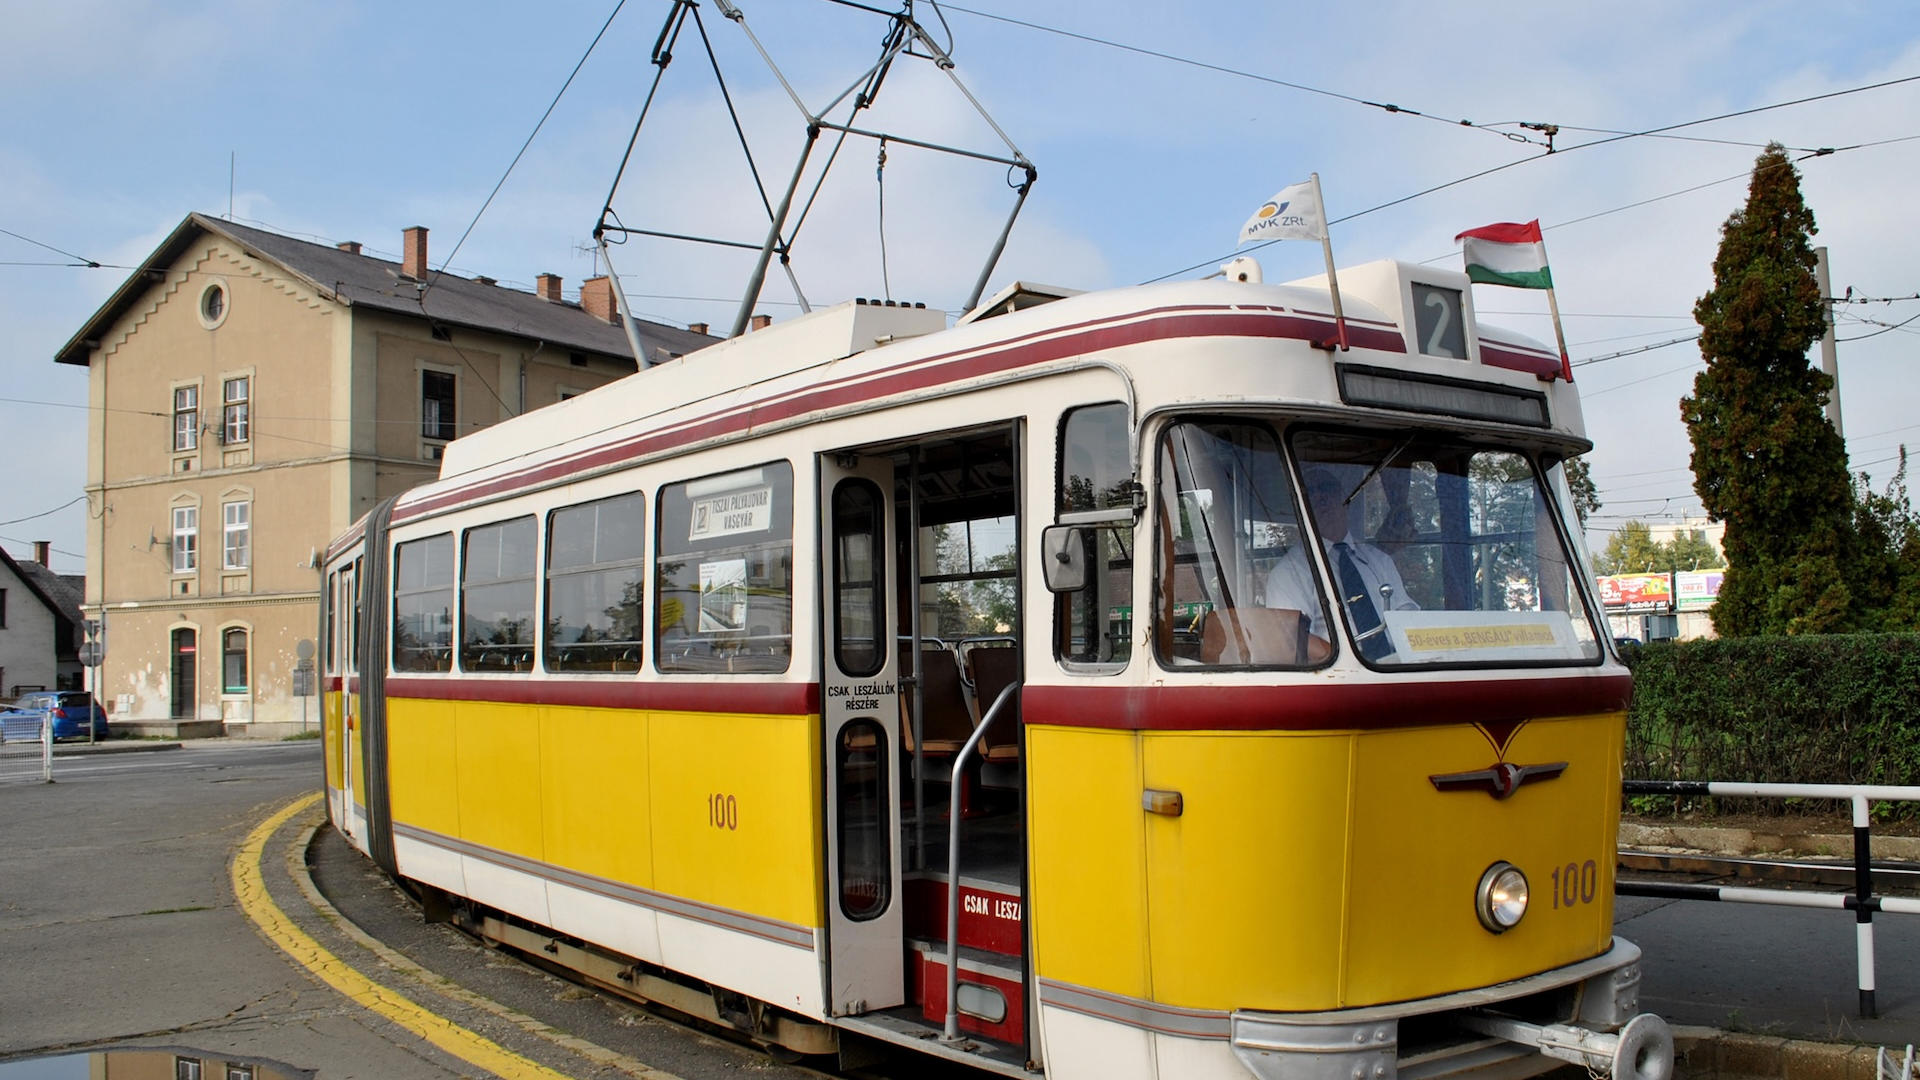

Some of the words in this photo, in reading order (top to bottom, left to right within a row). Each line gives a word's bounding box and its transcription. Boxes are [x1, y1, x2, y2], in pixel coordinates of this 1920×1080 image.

[1248, 218, 1279, 235] MVK
[1425, 292, 1453, 358] 2
[712, 498, 730, 514] TISZAI
[730, 491, 768, 511] PÁLYAUDVAR
[697, 505, 706, 529] 2
[724, 510, 753, 530] VASGYÁR
[1513, 628, 1555, 642] villamos
[828, 686, 850, 697] CSAK
[854, 680, 895, 696] LESZÁLLÓK
[846, 696, 879, 710] RÉSZÉRE
[708, 793, 737, 831] 100
[1551, 859, 1596, 910] 100
[964, 894, 989, 916] CSAK
